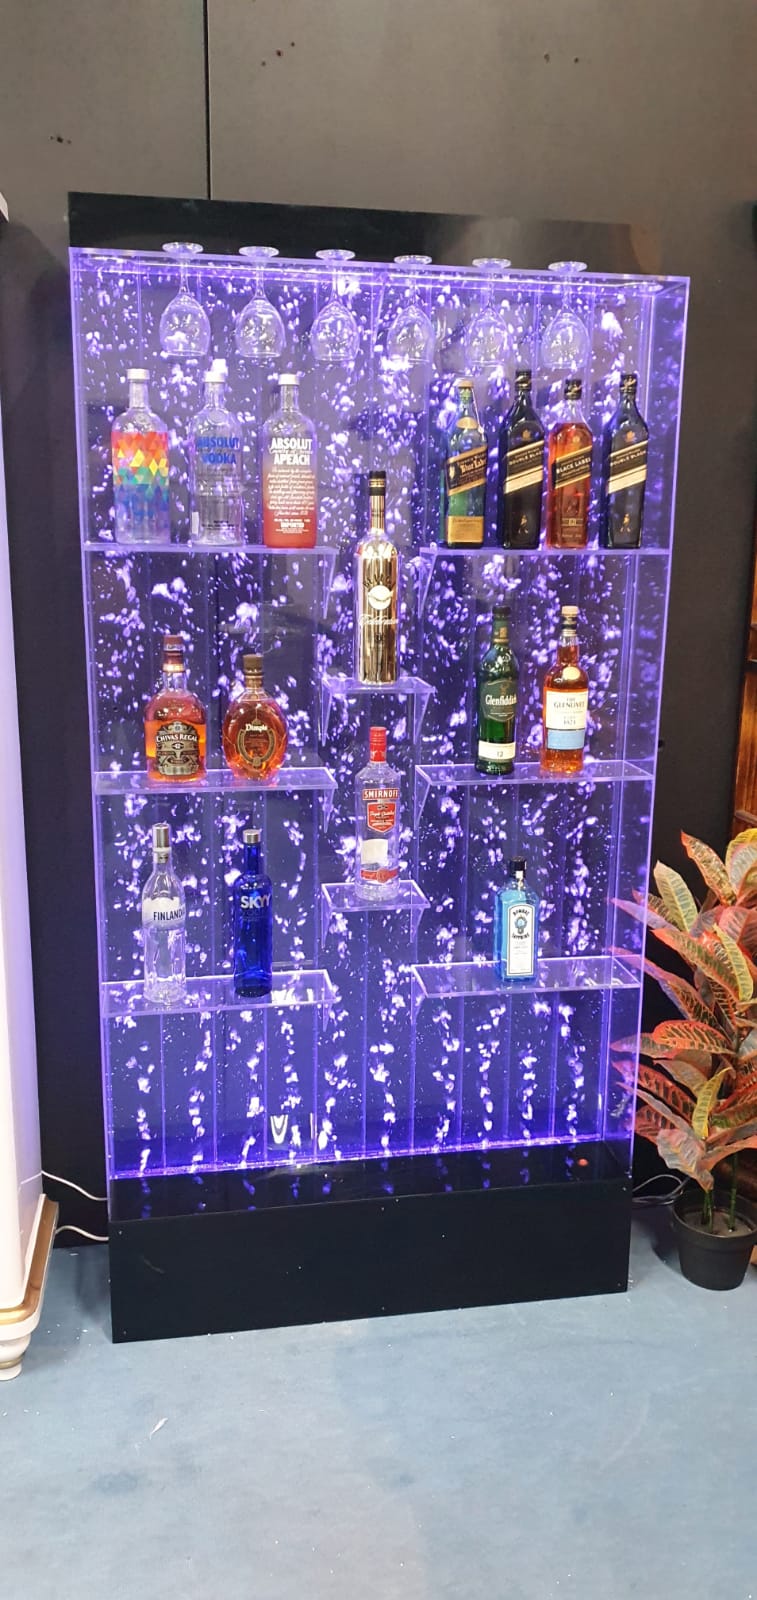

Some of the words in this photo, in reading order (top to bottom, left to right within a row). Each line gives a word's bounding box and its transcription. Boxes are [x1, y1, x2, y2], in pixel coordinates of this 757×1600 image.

[197, 436, 239, 449] ABSOLUT
[270, 437, 312, 450] ABSOLUT
[202, 453, 237, 464] VODKA
[273, 453, 310, 465] APEACH
[556, 462, 574, 474] BLACK
[574, 457, 591, 468] LABEL
[156, 733, 179, 742] CHIVAS
[179, 733, 198, 742] REGAL
[364, 789, 398, 799] SMIRNOFF
[240, 894, 271, 909] SKYY
